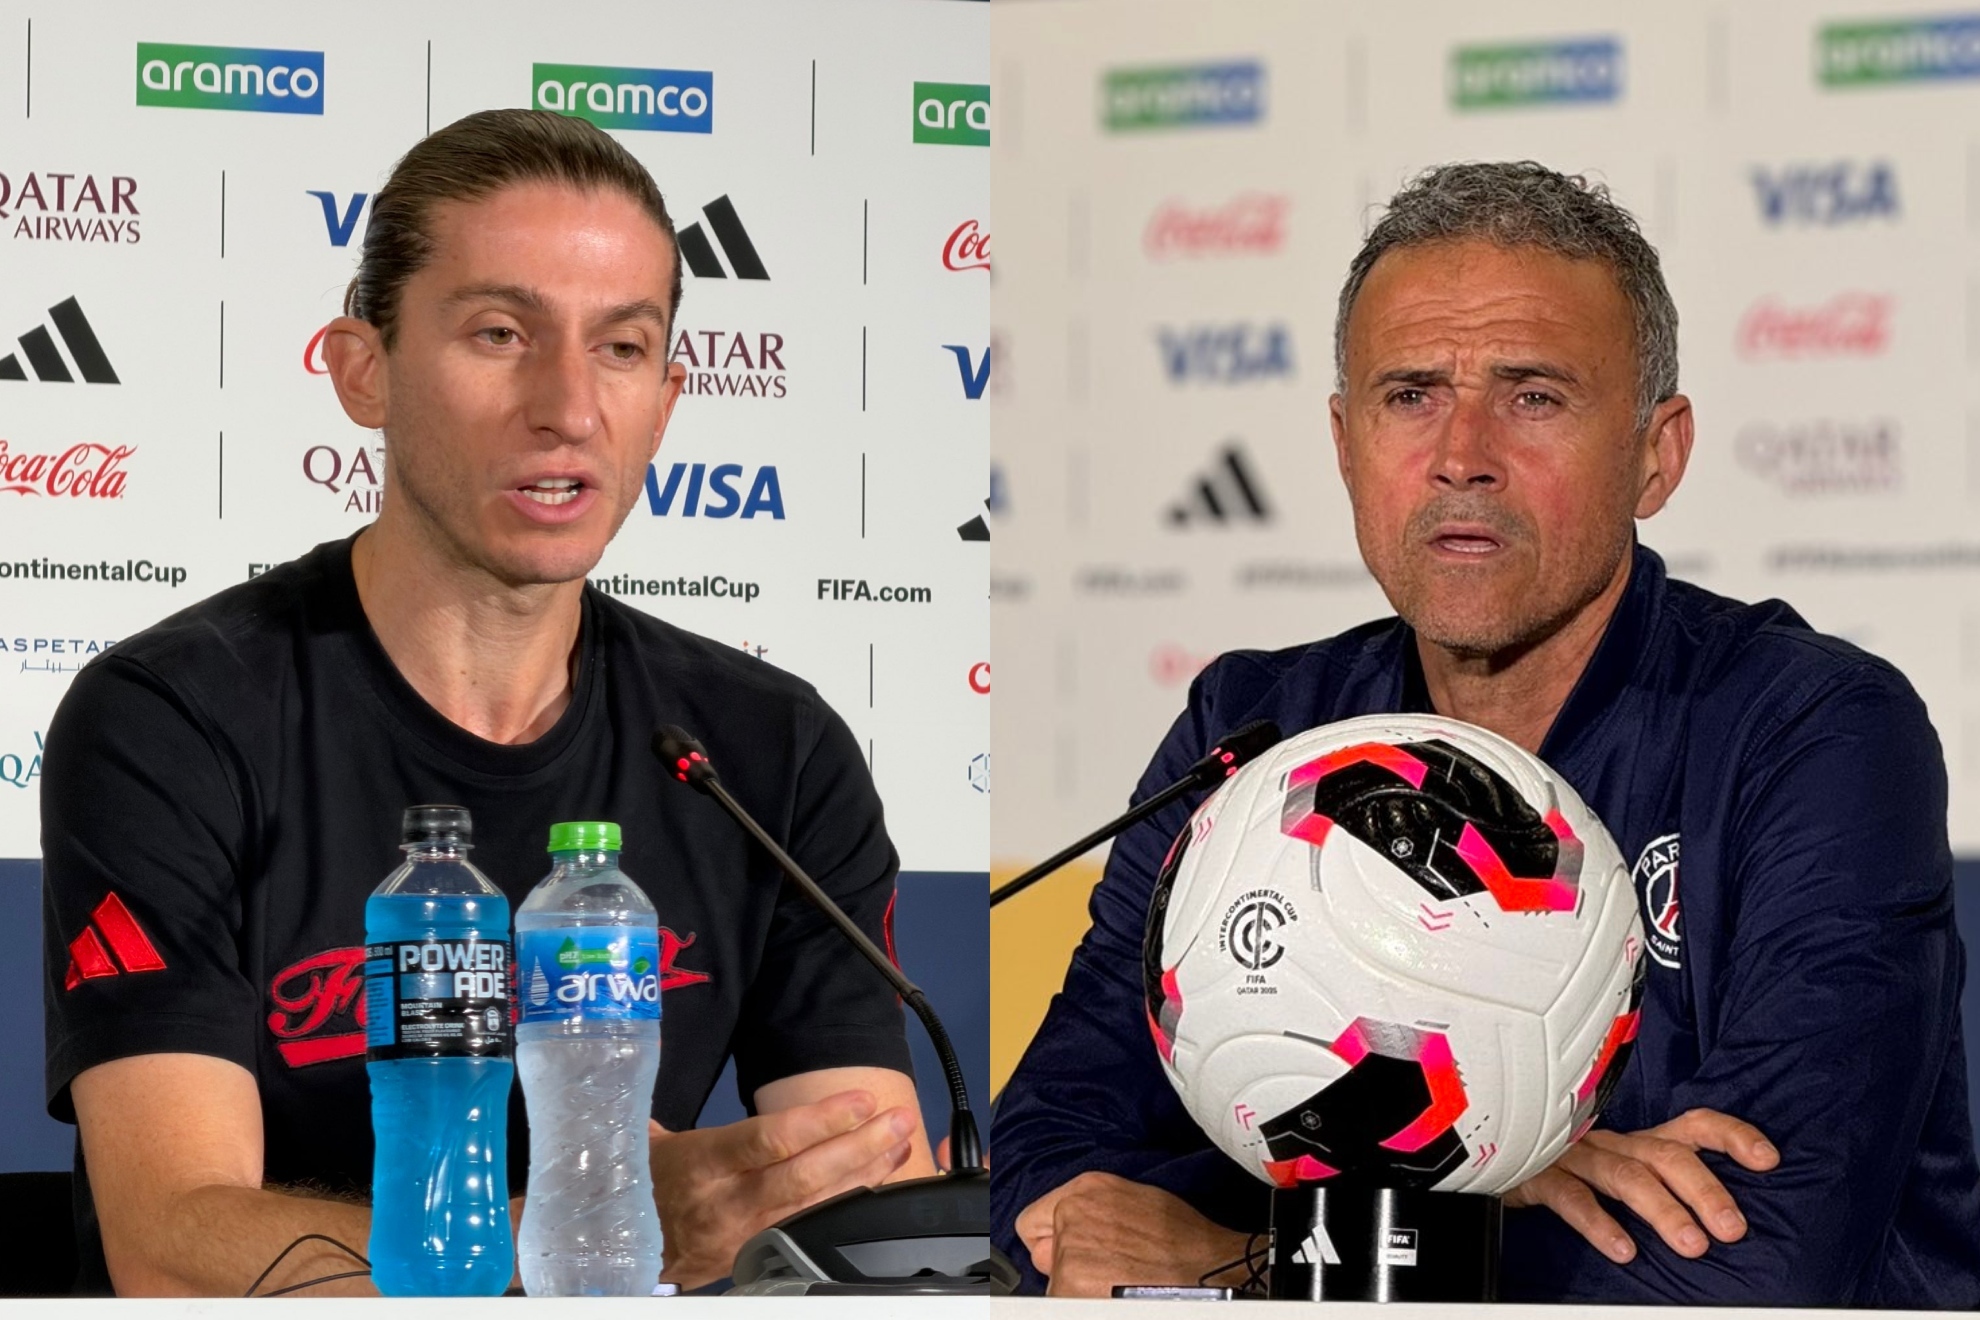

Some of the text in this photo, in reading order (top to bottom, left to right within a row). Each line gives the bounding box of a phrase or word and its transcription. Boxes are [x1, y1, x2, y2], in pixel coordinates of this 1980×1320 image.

[142, 59, 319, 98] aramco
[537, 80, 708, 117] aramco
[918, 98, 990, 130] ara
[0, 171, 140, 219] ATAR
[1752, 160, 1901, 225] VISA
[14, 215, 141, 244] AIRWAYS
[670, 329, 786, 370] ATAR
[1156, 322, 1294, 384] VISA
[681, 372, 787, 398] IRWAYS
[0, 440, 138, 499] ca-Cola
[645, 462, 785, 520] VISA
[0, 557, 187, 588] ontinentalCup
[587, 573, 760, 603] ntinentalCup
[817, 578, 931, 603] FIFA.com
[1641, 842, 1680, 876] PAR
[1219, 889, 1298, 952] INTERCONTINENTAL CUP
[400, 943, 505, 972] POWER
[454, 971, 507, 999] ADE
[557, 973, 658, 1002] arwa
[1246, 974, 1266, 984] FIFA
[401, 1002, 443, 1010] MOUNTAIN
[401, 1023, 444, 1031] ELECTROLYTE
[1387, 1234, 1409, 1245] FIFA
